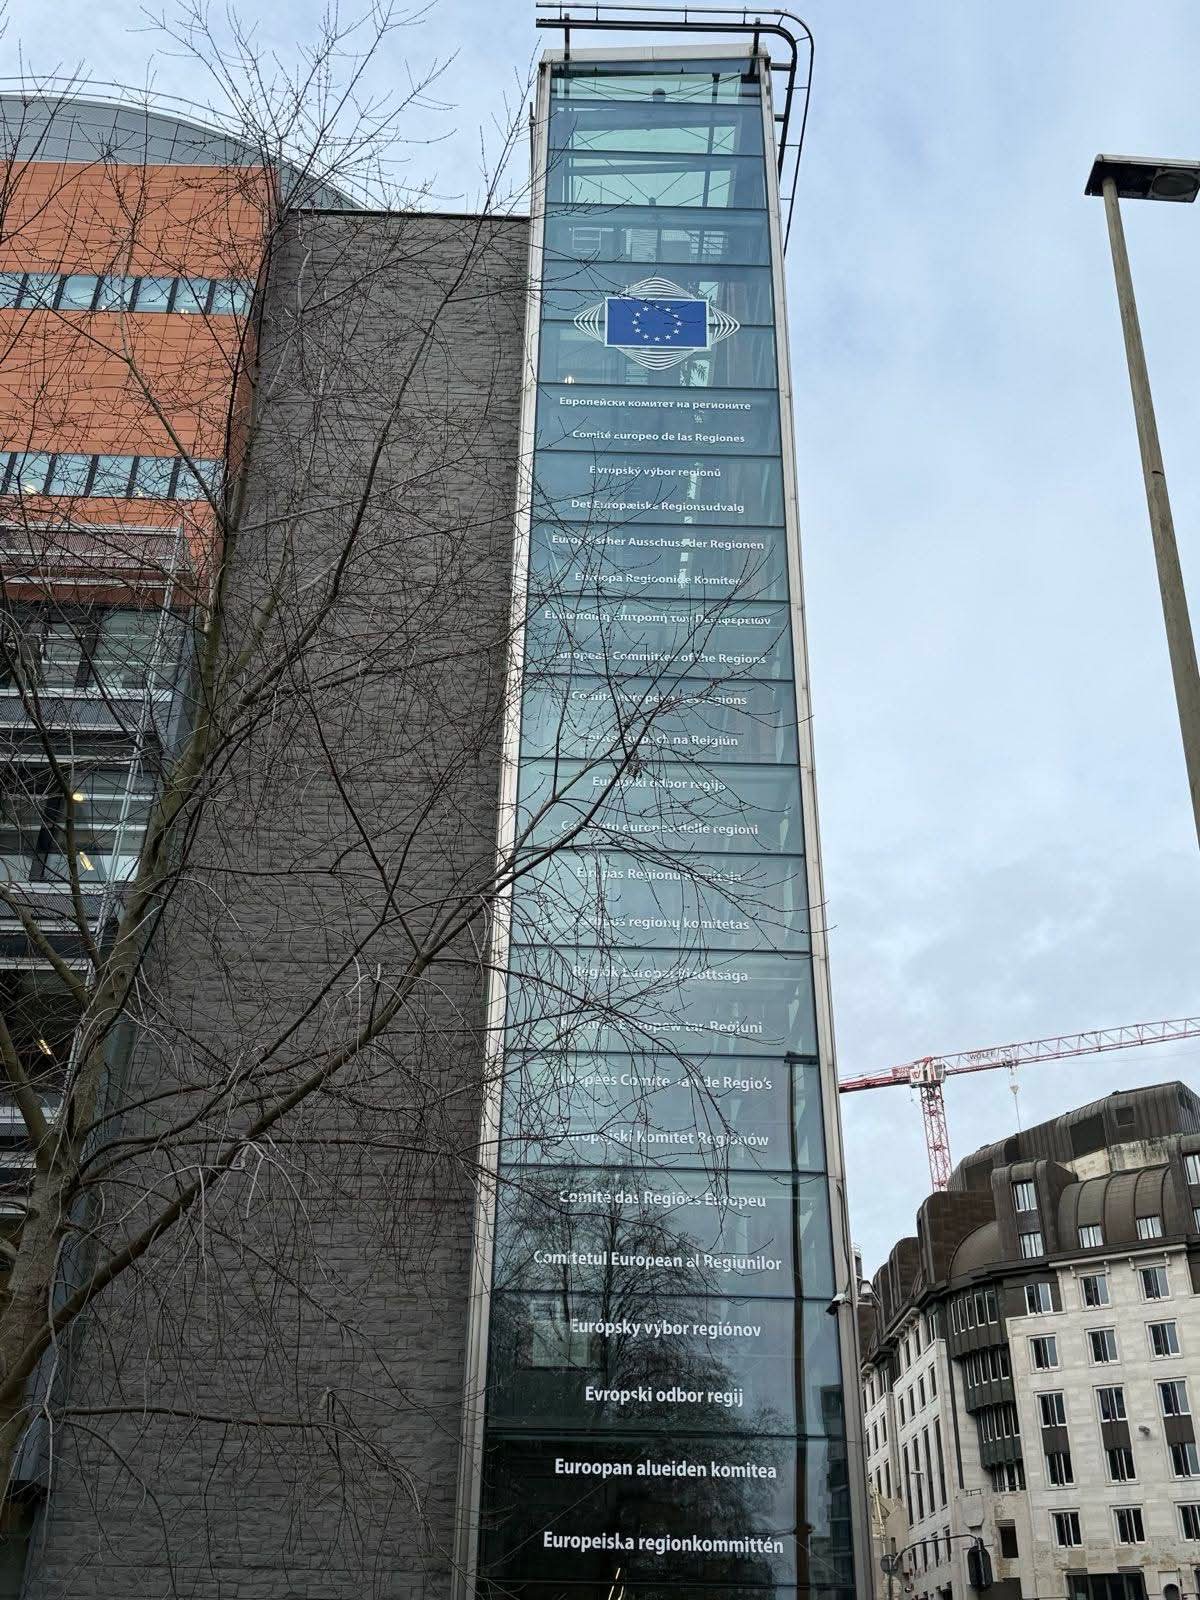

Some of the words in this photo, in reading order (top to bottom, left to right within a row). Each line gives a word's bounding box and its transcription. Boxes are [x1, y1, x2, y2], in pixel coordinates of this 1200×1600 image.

[559, 396, 626, 408] Европейски
[628, 399, 675, 409] комитет
[676, 401, 690, 409] на
[692, 401, 751, 412] регионите
[572, 429, 611, 439] Comité
[614, 432, 659, 443] europeo
[661, 432, 675, 441] de
[677, 433, 693, 442] las
[695, 433, 745, 444] Regiones
[589, 465, 642, 477] Evropský
[644, 466, 676, 477] výbor
[571, 500, 591, 509] Det
[661, 502, 745, 513] Regionsudvalg
[629, 536, 686, 547] Ausschuss
[688, 537, 707, 547] der
[710, 538, 764, 550] Regionen
[718, 653, 766, 666] Regions
[673, 736, 689, 745] na
[691, 733, 739, 747] Reigiún
[713, 824, 759, 836] regioni
[683, 918, 751, 930] komitetas
[704, 1076, 720, 1089] de
[559, 1190, 611, 1204] Comité
[614, 1190, 639, 1205] das
[533, 1250, 608, 1266] Comitetul
[611, 1252, 683, 1270] European
[687, 1253, 699, 1268] al
[703, 1254, 782, 1272] Regiunilor
[570, 1318, 641, 1340] Európsky
[644, 1319, 689, 1339] výbor
[692, 1320, 761, 1340] regiónov
[585, 1385, 652, 1405] Evropski
[655, 1387, 704, 1403] odbor
[707, 1388, 744, 1408] regij
[554, 1458, 633, 1479] Euroopan
[636, 1460, 707, 1477] alueiden
[711, 1461, 777, 1479] komitea
[543, 1531, 634, 1553] Europeiska
[638, 1534, 784, 1555] regionkommittén
